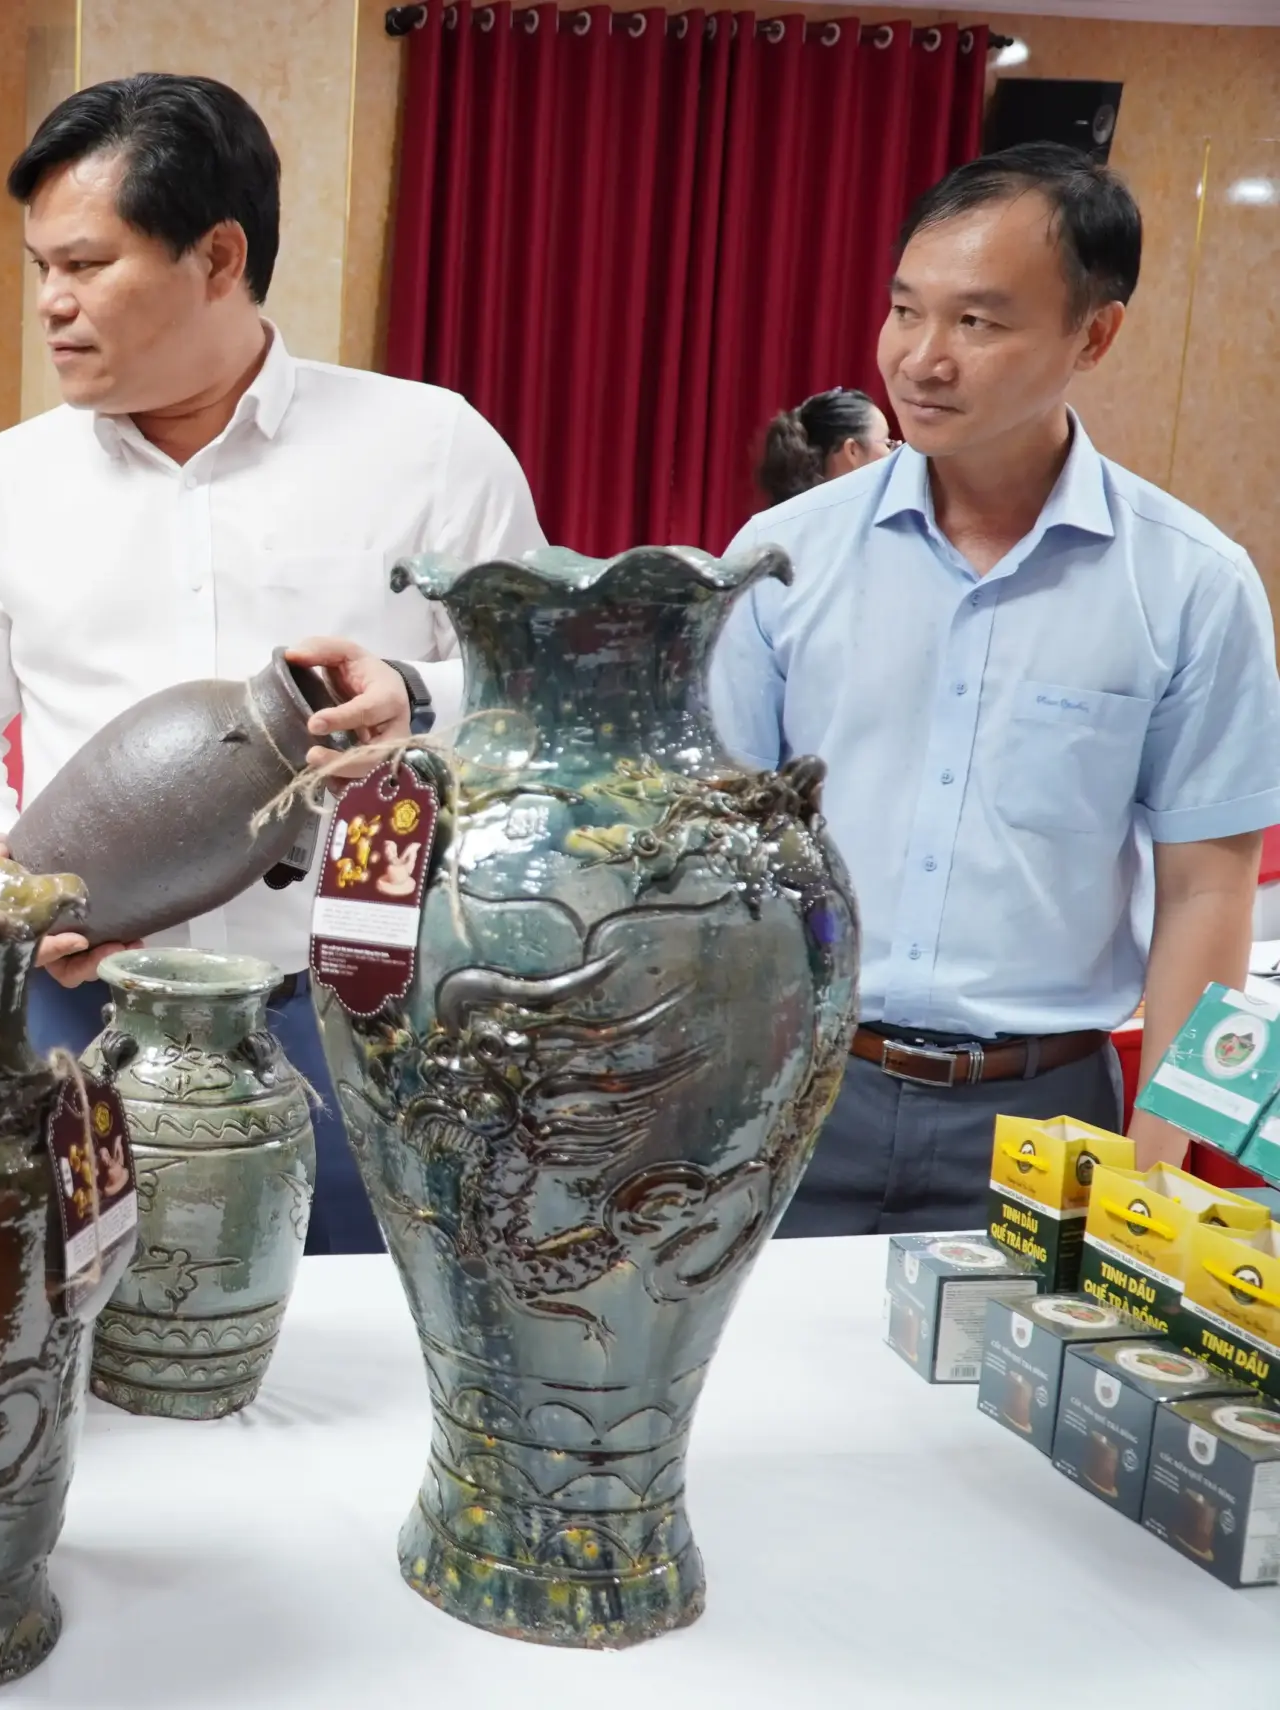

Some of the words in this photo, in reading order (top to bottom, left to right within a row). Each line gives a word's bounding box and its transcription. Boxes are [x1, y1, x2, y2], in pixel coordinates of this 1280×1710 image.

[1002, 1203, 1021, 1225] TINH
[1021, 1210, 1039, 1233] DẦU
[991, 1222, 1008, 1242] QUẾ
[1006, 1230, 1021, 1250] TRÀ
[1021, 1235, 1048, 1263] BỒNG
[1084, 1279, 1109, 1301] QUẾ
[1108, 1292, 1130, 1313] TRÀ
[1101, 1261, 1128, 1289] TINH
[1128, 1276, 1156, 1304] DẦU
[1201, 1329, 1235, 1360] TINH
[1234, 1348, 1270, 1379] DẦU
